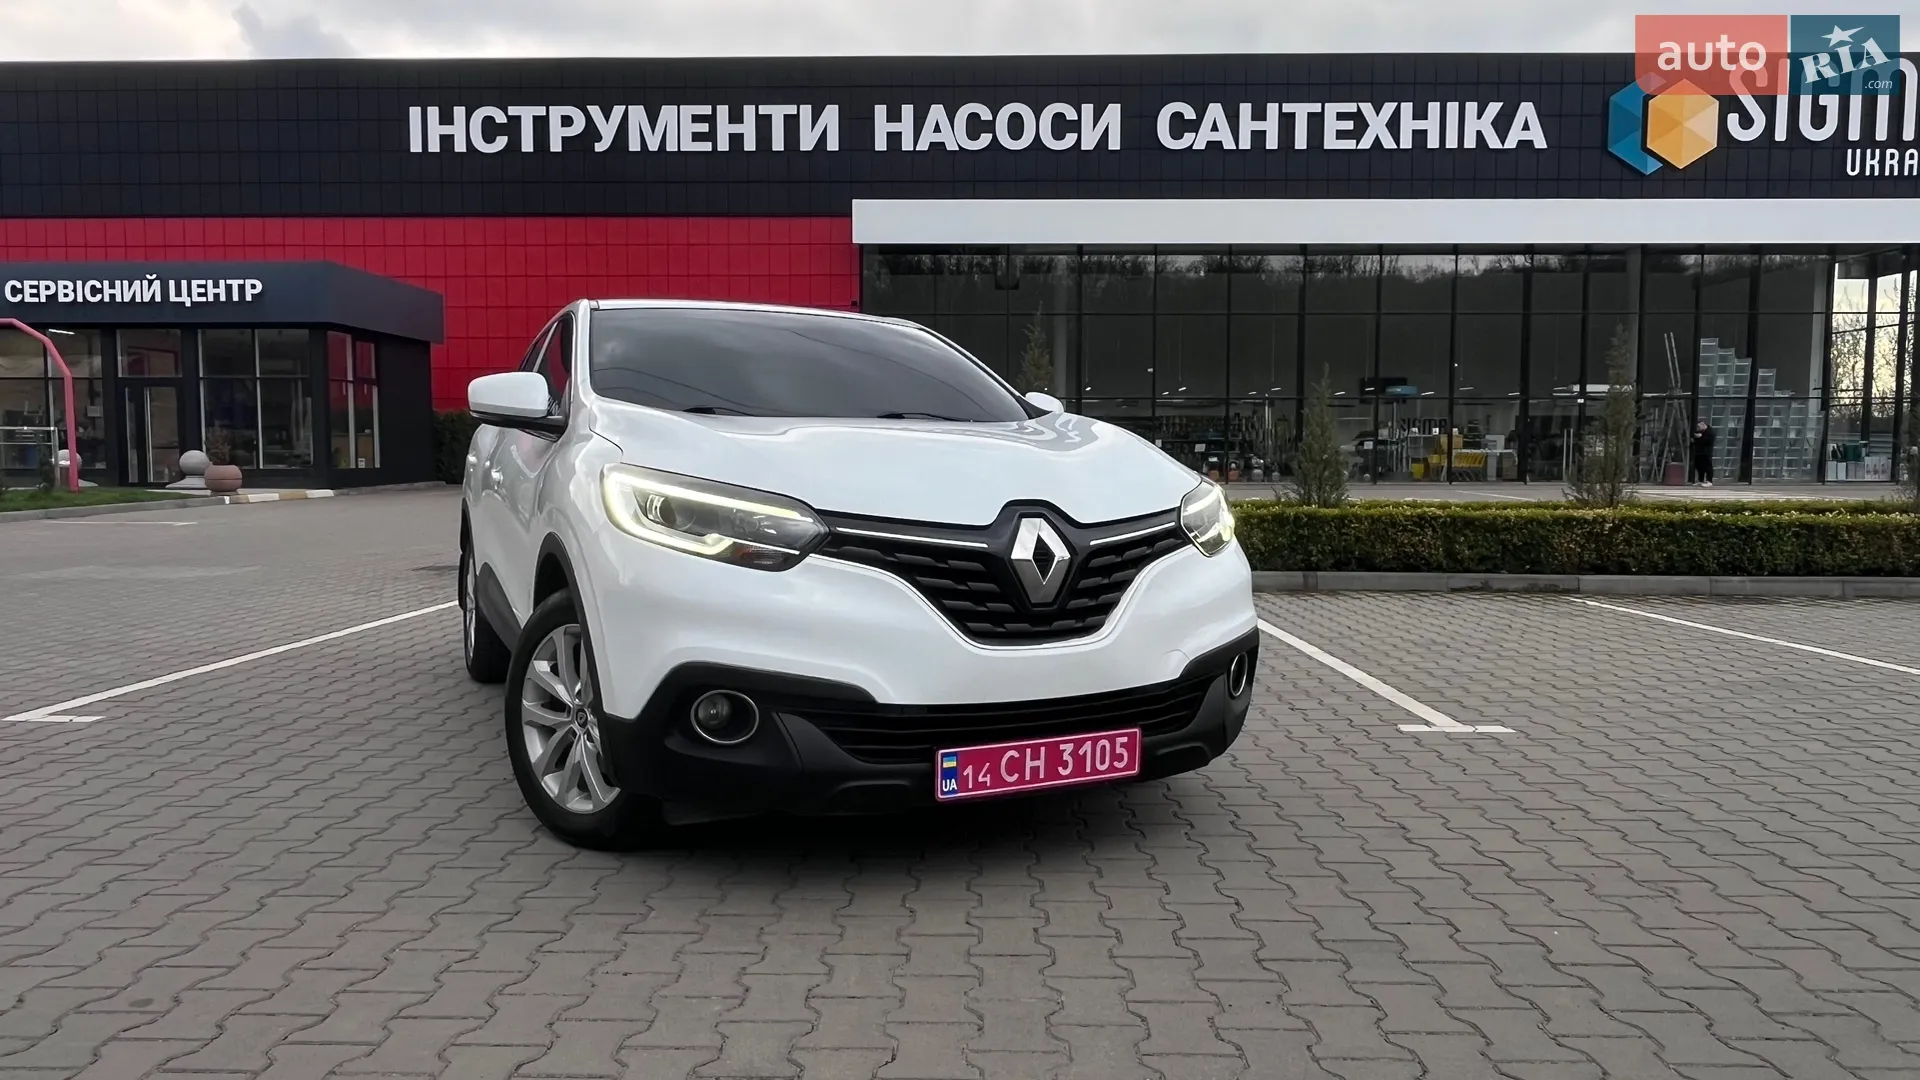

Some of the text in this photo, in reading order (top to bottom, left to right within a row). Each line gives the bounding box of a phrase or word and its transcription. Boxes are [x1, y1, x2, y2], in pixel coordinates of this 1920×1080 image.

[408, 101, 1548, 154] ІНСТРУМЕНТИ НАСОСИ САНТЕХНІКА
[5, 274, 263, 307] СЕРВІСНИЙ ЦЕНТР
[963, 762, 990, 788] 14
[1057, 736, 1129, 776] 3105
[942, 778, 957, 792] UA
